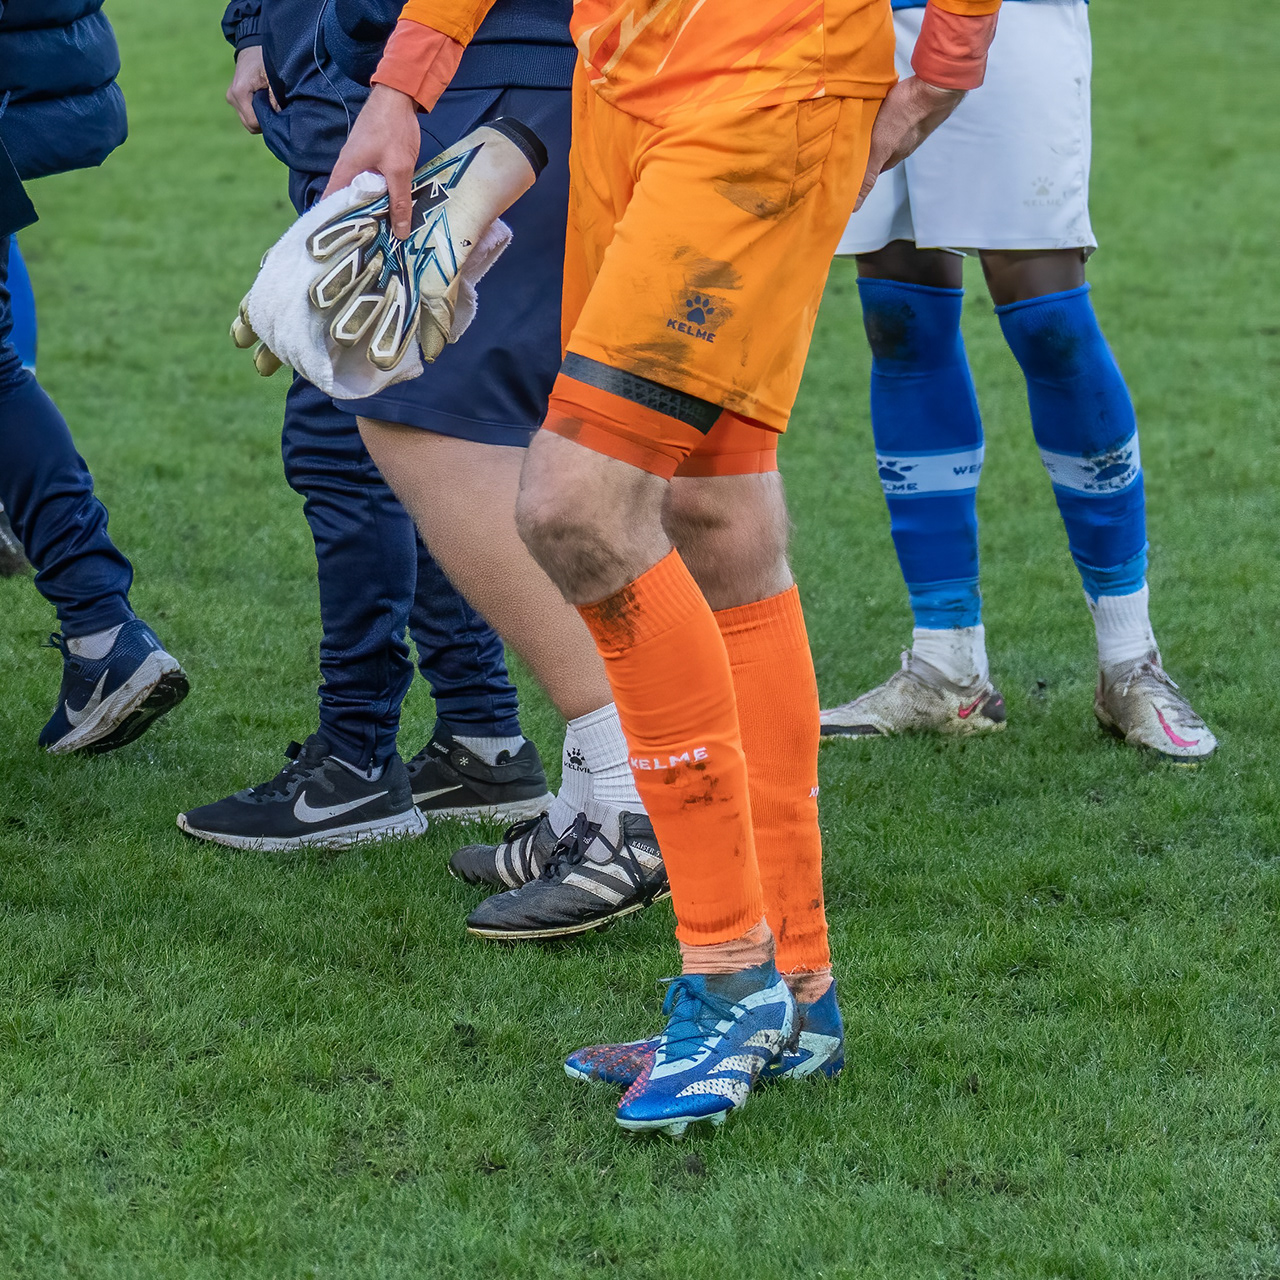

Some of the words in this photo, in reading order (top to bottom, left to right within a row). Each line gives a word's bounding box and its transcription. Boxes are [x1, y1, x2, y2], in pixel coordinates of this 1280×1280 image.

[666, 318, 717, 344] KELME
[629, 746, 709, 771] KELME
[631, 841, 655, 854] KAISER
